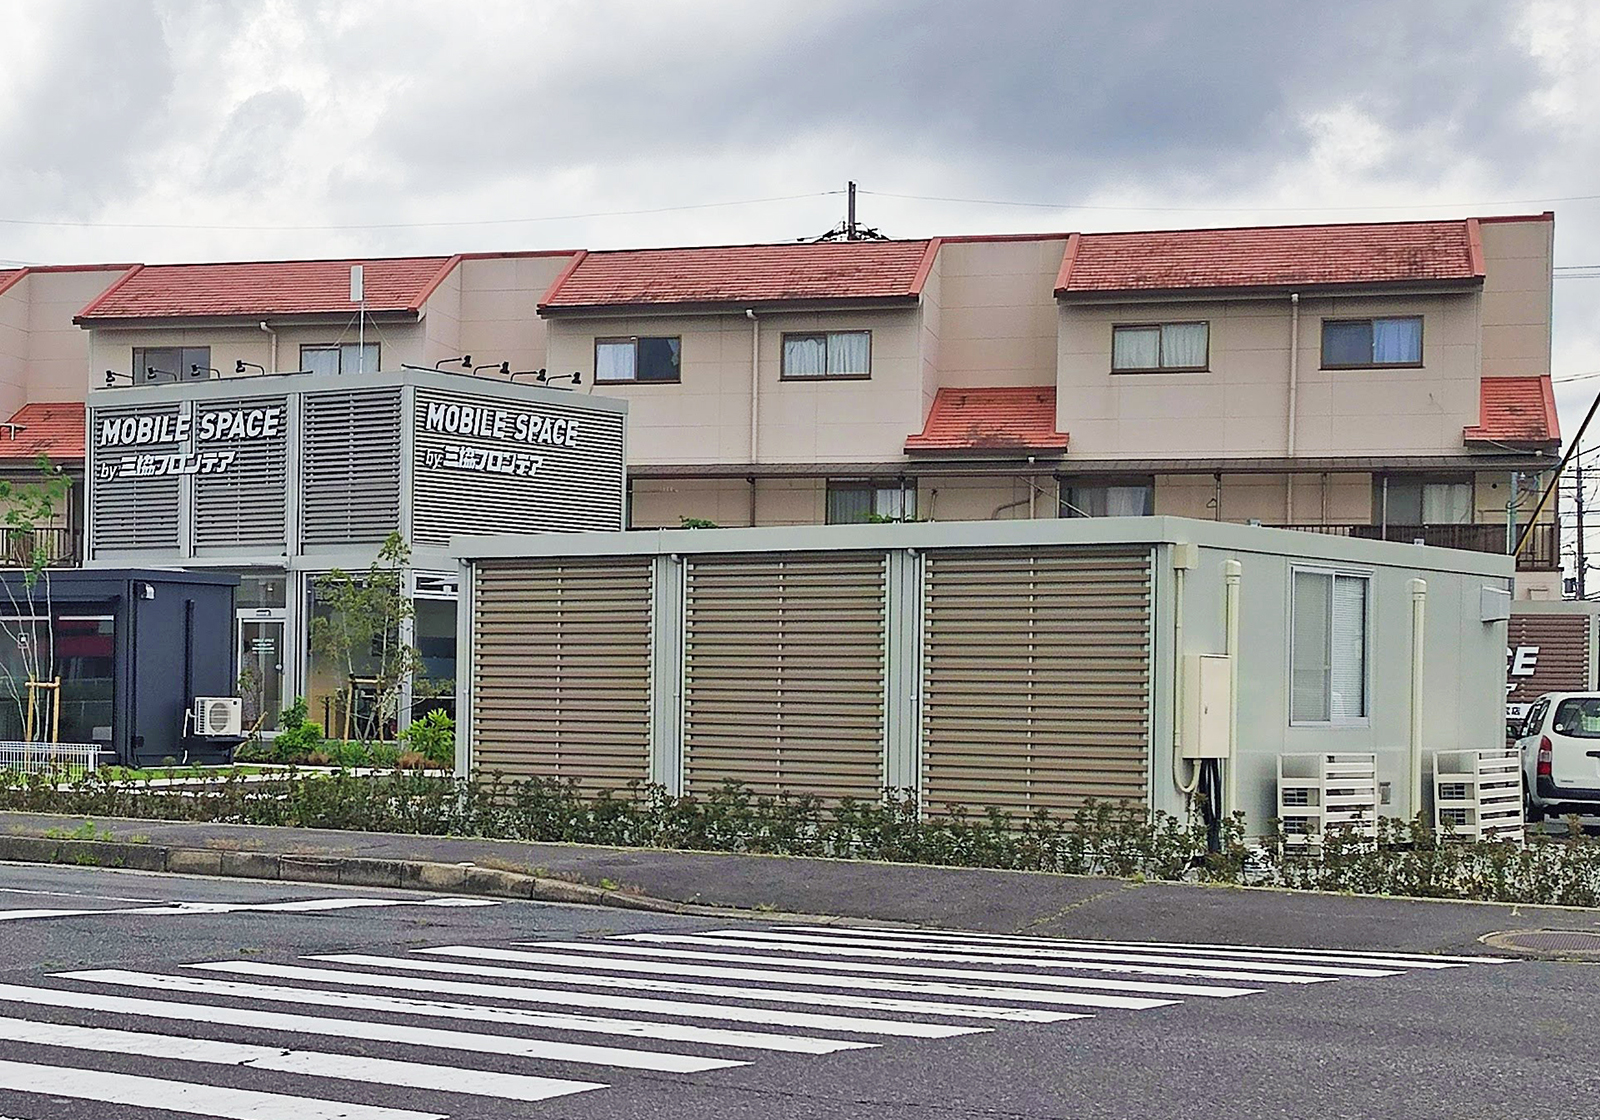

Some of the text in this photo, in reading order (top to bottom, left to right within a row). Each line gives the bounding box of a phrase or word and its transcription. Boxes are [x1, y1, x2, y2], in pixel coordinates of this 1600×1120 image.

[100, 408, 282, 446] MOBILE SPACE
[426, 402, 580, 447] MOBILE SPACE
[101, 463, 118, 481] by
[425, 449, 440, 470] by
